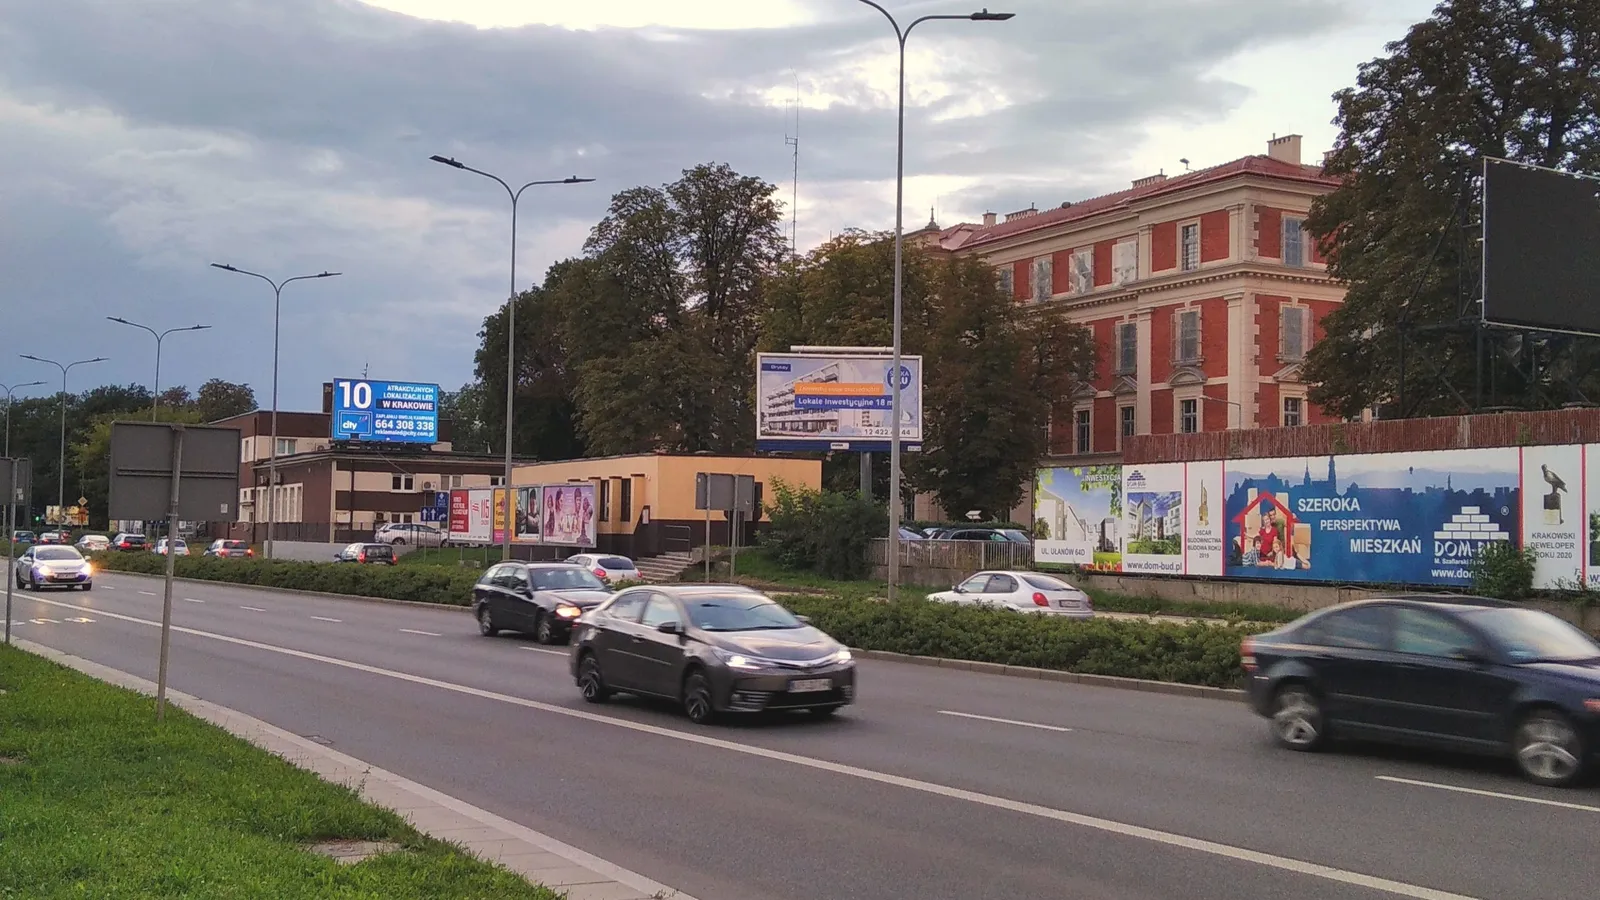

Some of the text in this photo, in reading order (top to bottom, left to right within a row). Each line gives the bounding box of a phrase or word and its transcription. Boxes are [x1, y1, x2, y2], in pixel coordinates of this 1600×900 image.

[387, 385, 434, 393] ATRAKCYJNYCH
[338, 381, 372, 409] 10
[382, 400, 434, 410] W KRAKOWIE
[798, 397, 823, 406] Lokale
[877, 399, 885, 407] 18
[375, 420, 434, 431] 664 308 338
[1084, 474, 1121, 482] INWESTYCJA
[1298, 497, 1360, 512] SZEROKA
[1320, 519, 1401, 531] PERSPEKTYWA
[1531, 532, 1576, 540] KRAKOWSKI
[1350, 535, 1422, 554] MIESZKAŃ
[1530, 541, 1576, 550] DEWELOPER
[1050, 547, 1075, 556] UŁANÓW
[1534, 551, 1555, 559] ROKU
[1127, 561, 1182, 571] www.dom-bud.pl
